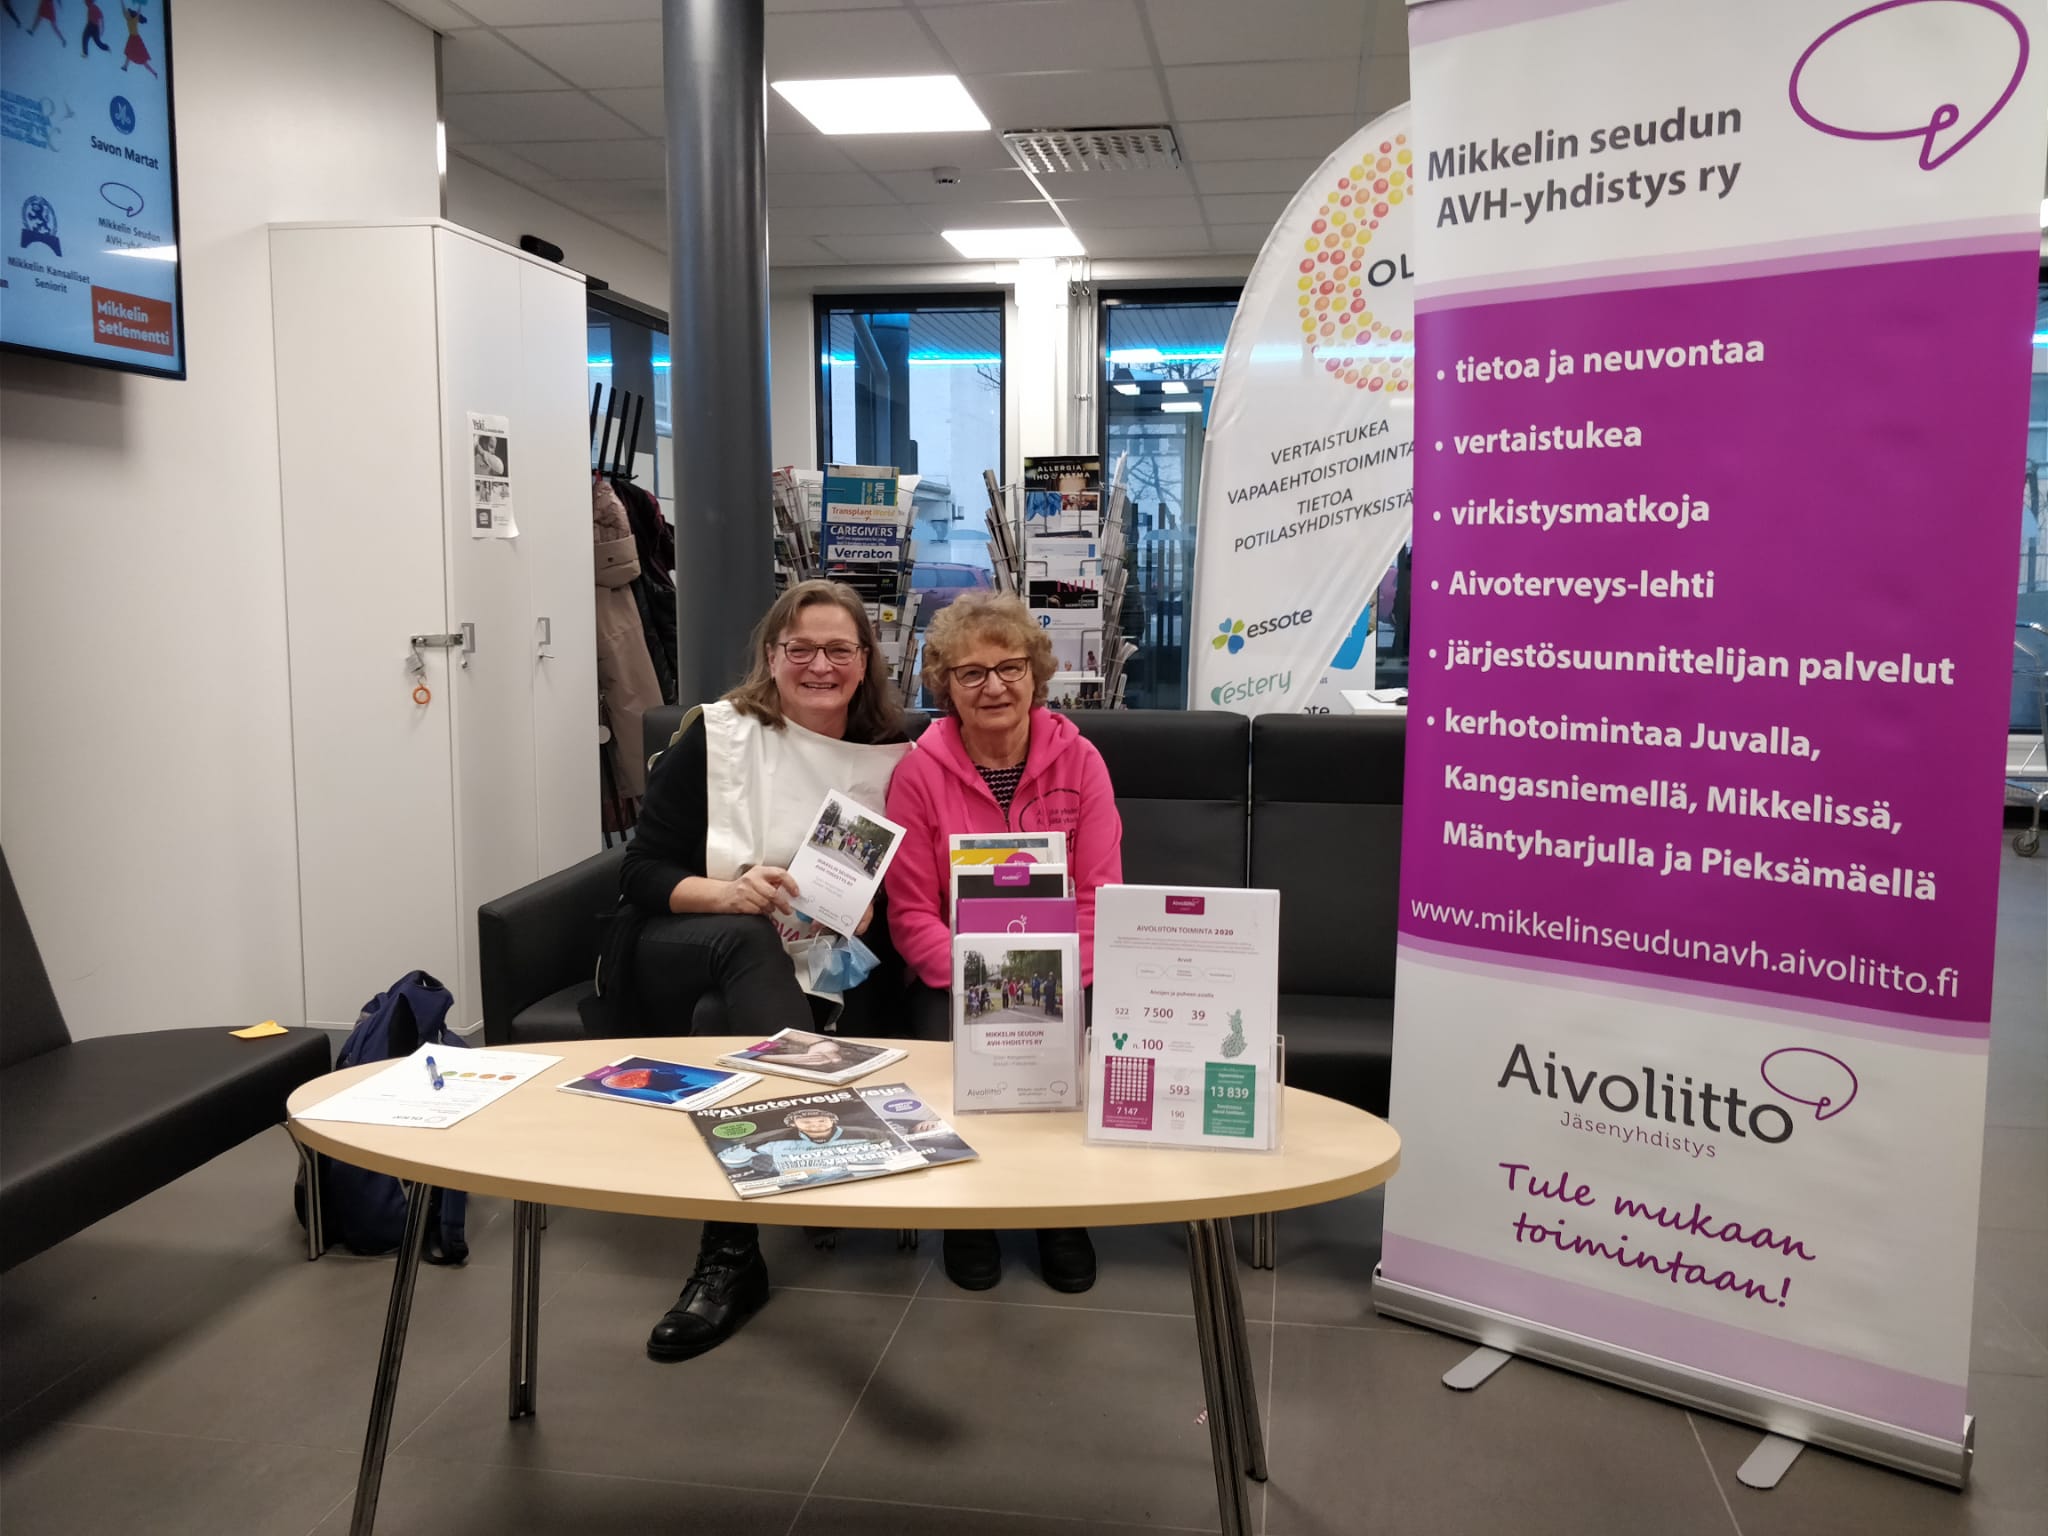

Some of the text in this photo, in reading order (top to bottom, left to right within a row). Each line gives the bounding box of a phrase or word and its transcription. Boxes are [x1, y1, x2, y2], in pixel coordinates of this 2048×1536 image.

[91, 135, 159, 170] Savon Martat
[1427, 106, 1742, 182] Mikkelin seudun
[1436, 162, 1742, 228] AVH-yhdistys ry
[1367, 253, 1414, 288] OL
[97, 300, 149, 324] Mikkelin
[98, 319, 170, 346] Setlementti
[1455, 339, 1765, 384] tietoa ja neuvontaa
[1271, 419, 1390, 465] VERTAISTUKEA
[1454, 420, 1642, 455] vertaistukea
[1227, 440, 1415, 505] VAPAAEHTOISTOIMINTA
[831, 506, 872, 517] Transplant
[1234, 487, 1414, 552] POTILASYHDISTYKSISTÄ
[1297, 488, 1353, 516] TIETOA
[1451, 494, 1710, 532] virkistysmatkoja
[834, 547, 893, 559] Verraton
[1448, 569, 1715, 604] Aivoterveys-lehti
[1246, 608, 1313, 638] essote
[1445, 639, 1956, 686] järjestösuunnittelijan palvelut
[1223, 671, 1292, 705] estery
[1444, 707, 1822, 762] kerhotoimintaa Juvalla,
[1444, 765, 1903, 834] Kangasniemellä, Mikkelissä,
[1443, 821, 1937, 901] Mäntyharjulla ja Pieksämäellä
[1179, 926, 1213, 935] TOIMINTA
[1410, 898, 1960, 998] www.mikkelinseudunavh.aivoliitto.fi
[1114, 1007, 1129, 1015] 522
[1152, 1008, 1174, 1019] 500
[1191, 1009, 1206, 1020] 39
[1142, 1038, 1164, 1050] 100
[720, 1091, 852, 1118] Aivoterveys
[1169, 1084, 1191, 1096] 593
[1210, 1086, 1249, 1098] 13 839
[1497, 1043, 1794, 1144] Aivoliitto
[1170, 1109, 1185, 1118] 190
[1560, 1111, 1717, 1158] Jäsenyhdistys
[1499, 1162, 1816, 1261] Tule mukaan
[1512, 1212, 1791, 1308] toimintaan!
